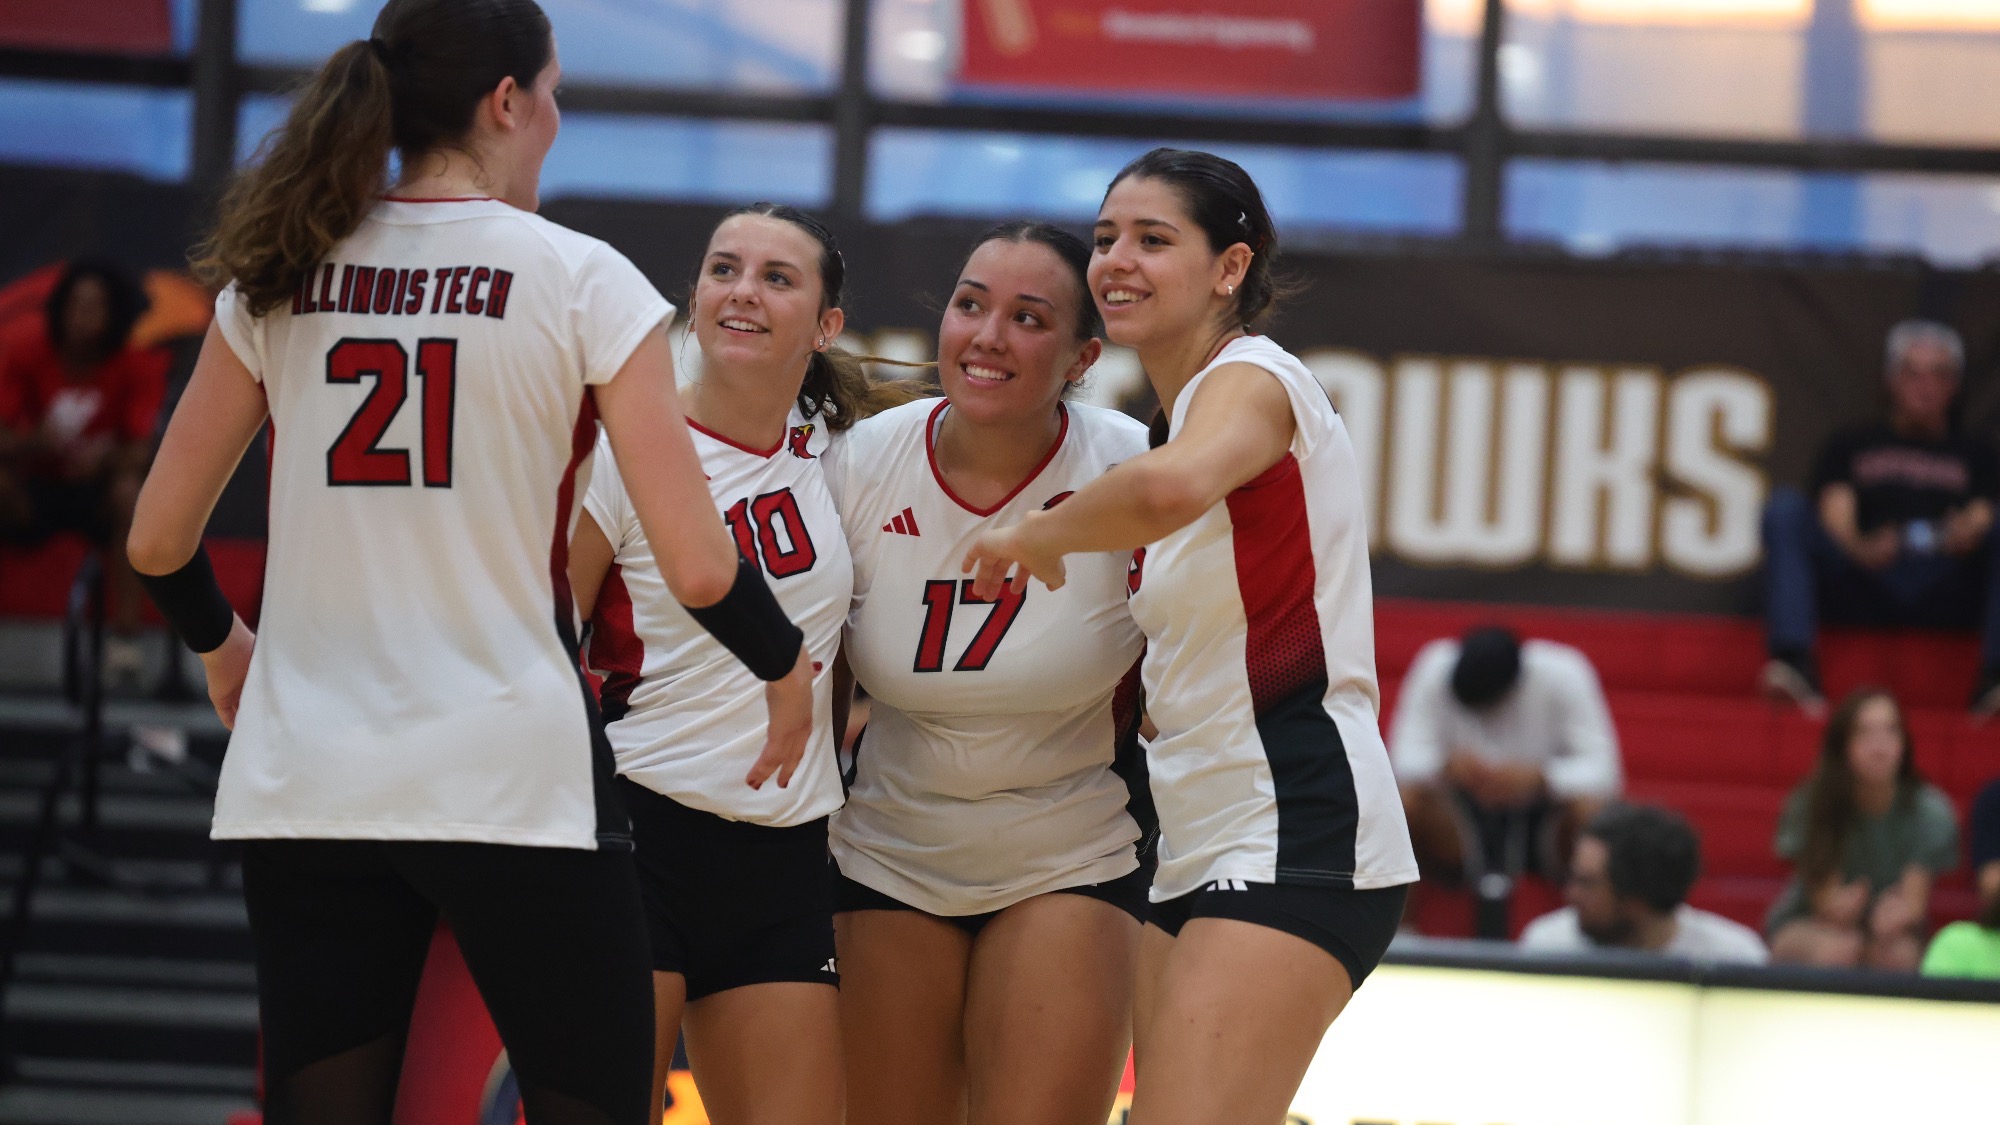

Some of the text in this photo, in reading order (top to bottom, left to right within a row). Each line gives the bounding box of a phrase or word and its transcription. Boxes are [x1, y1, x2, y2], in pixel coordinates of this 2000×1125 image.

[430, 266, 514, 320] TECH
[326, 337, 457, 488] 21
[1301, 347, 1773, 579] WKS
[724, 486, 817, 580] 10
[913, 577, 1028, 673] 17
